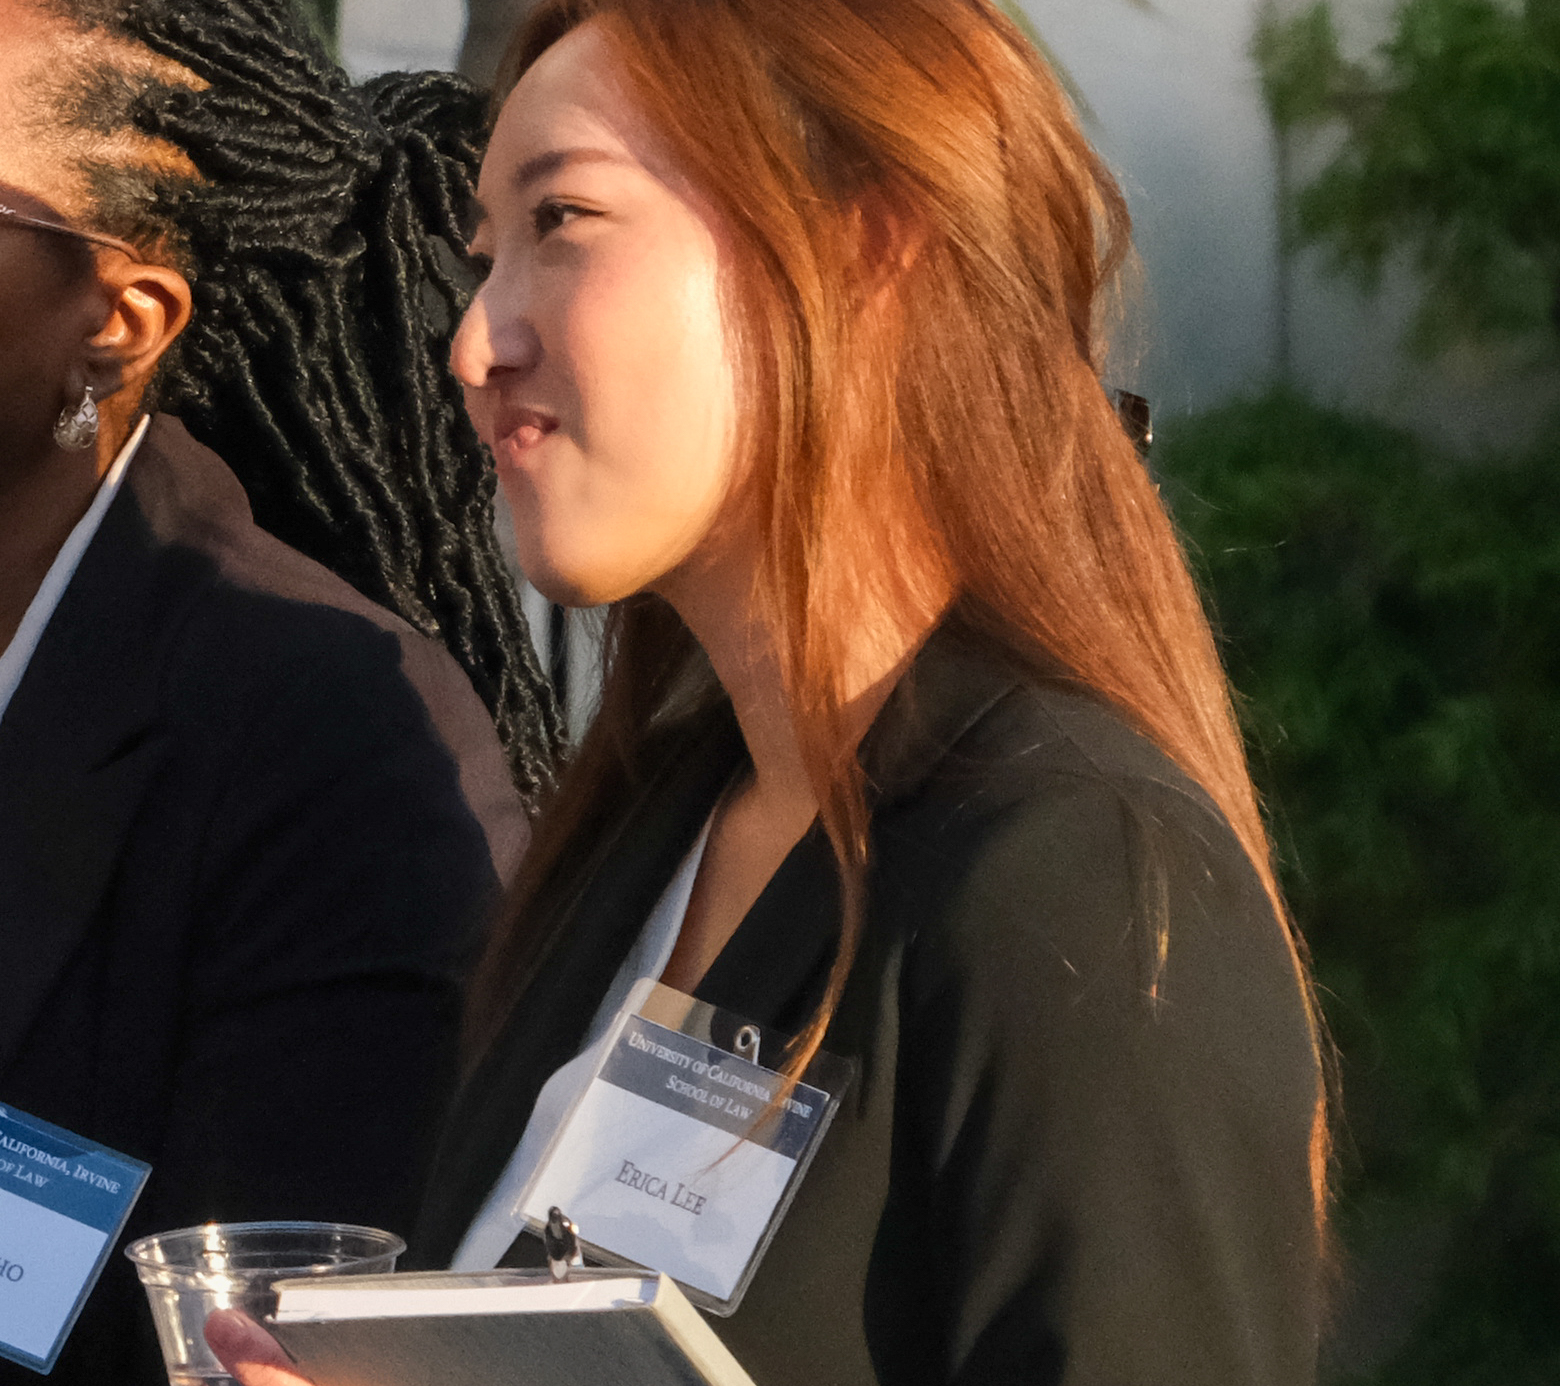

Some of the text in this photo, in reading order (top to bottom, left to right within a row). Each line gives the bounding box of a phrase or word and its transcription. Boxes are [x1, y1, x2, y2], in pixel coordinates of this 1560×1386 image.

[628, 1031, 693, 1069] UNIVERSITY
[692, 1061, 708, 1074] OF
[666, 1075, 753, 1120] SCHOOL OF LAW
[15, 1164, 50, 1189] LAW
[73, 1164, 121, 1195] IRVINE
[615, 1160, 707, 1215] ERICA LEE
